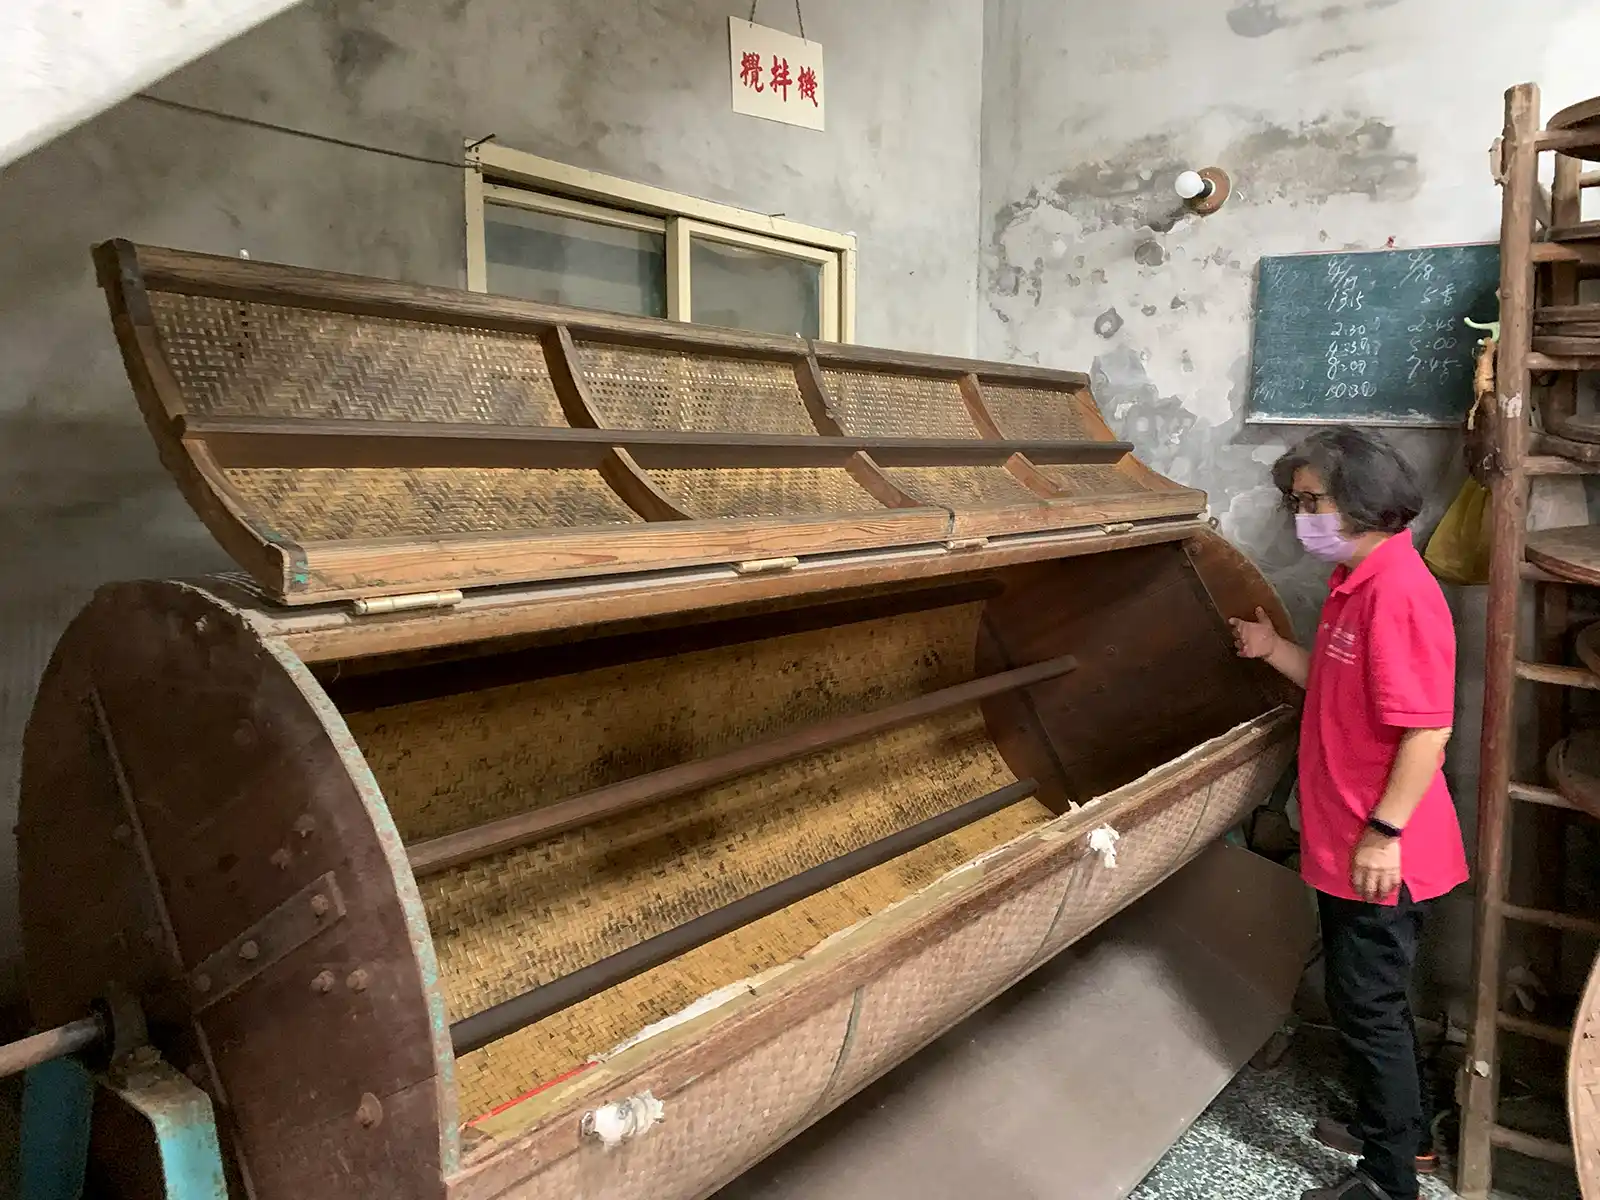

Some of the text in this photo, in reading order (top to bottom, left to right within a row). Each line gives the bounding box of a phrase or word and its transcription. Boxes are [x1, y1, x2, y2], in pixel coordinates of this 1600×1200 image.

[739, 51, 818, 107] 攪拌機
[1407, 314, 1456, 332] 2:45
[1409, 336, 1457, 351] 5:00
